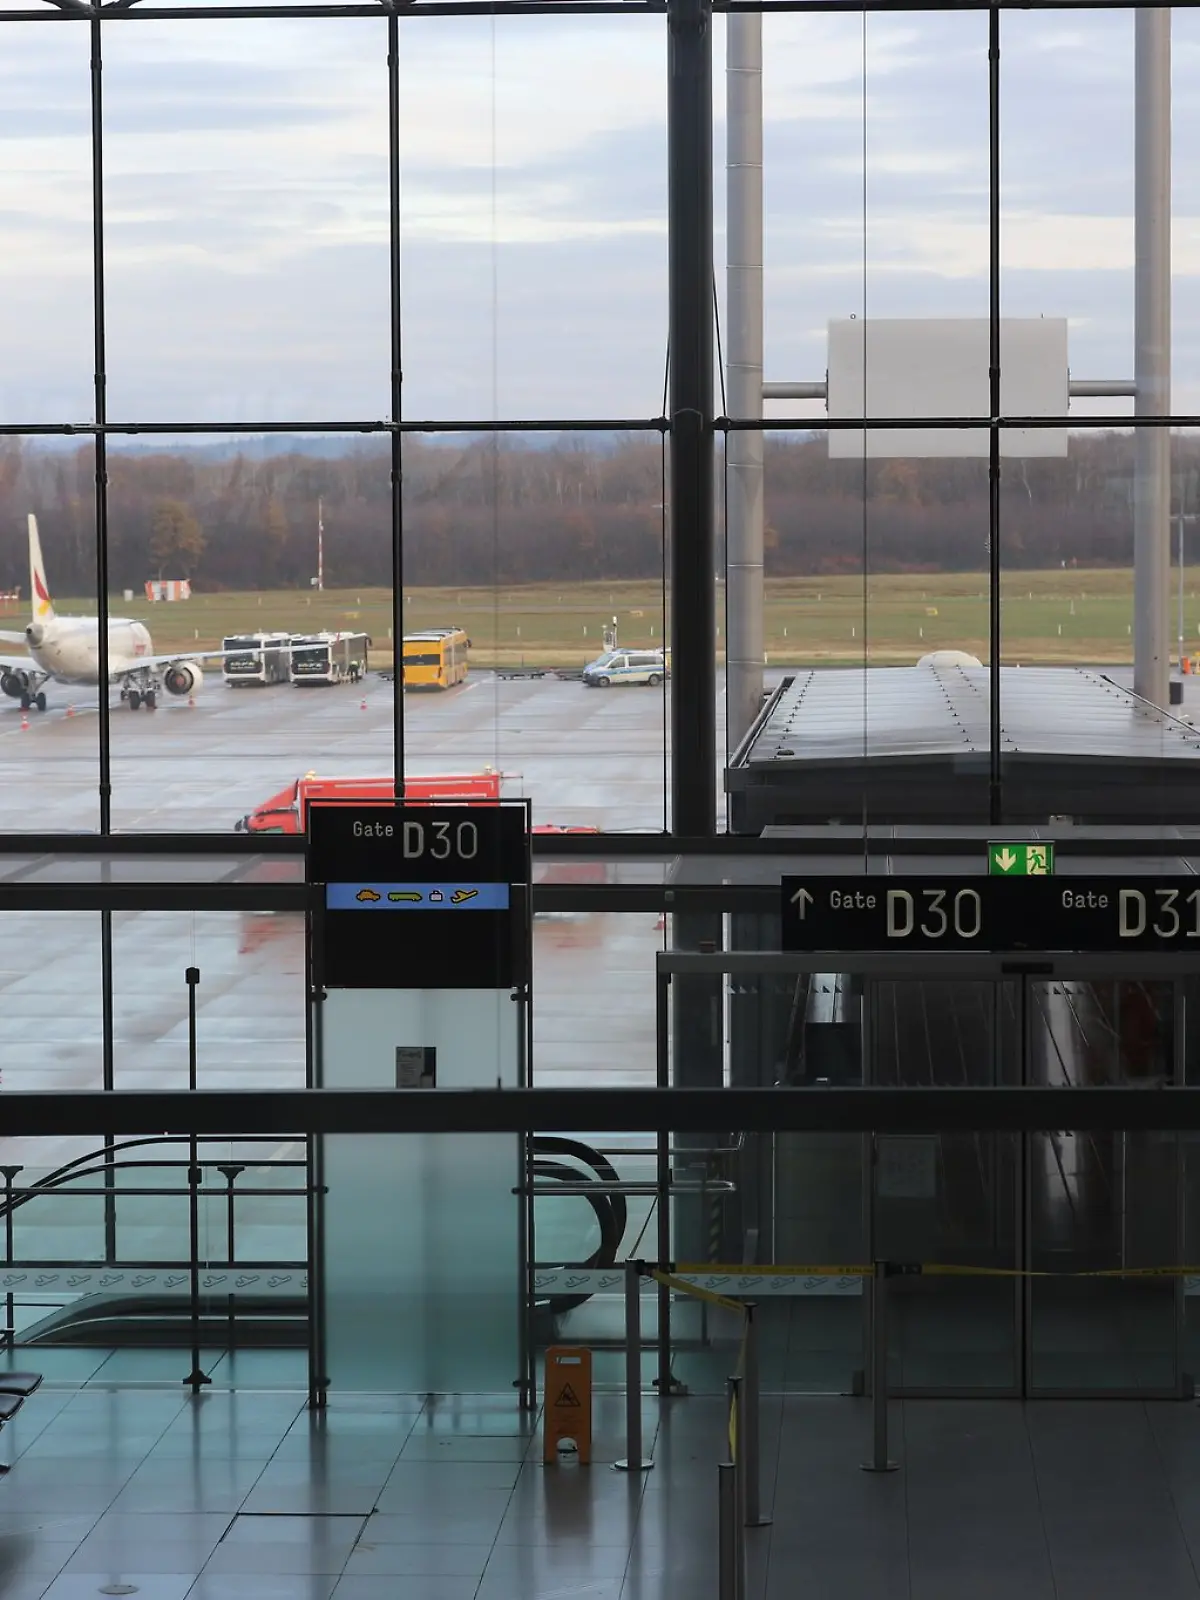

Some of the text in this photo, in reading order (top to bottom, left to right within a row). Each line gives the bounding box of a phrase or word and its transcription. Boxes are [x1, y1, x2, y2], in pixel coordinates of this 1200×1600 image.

[353, 821, 478, 859] Gate D30
[830, 889, 981, 938] Gate D30
[1062, 889, 1200, 938] Gate D31
